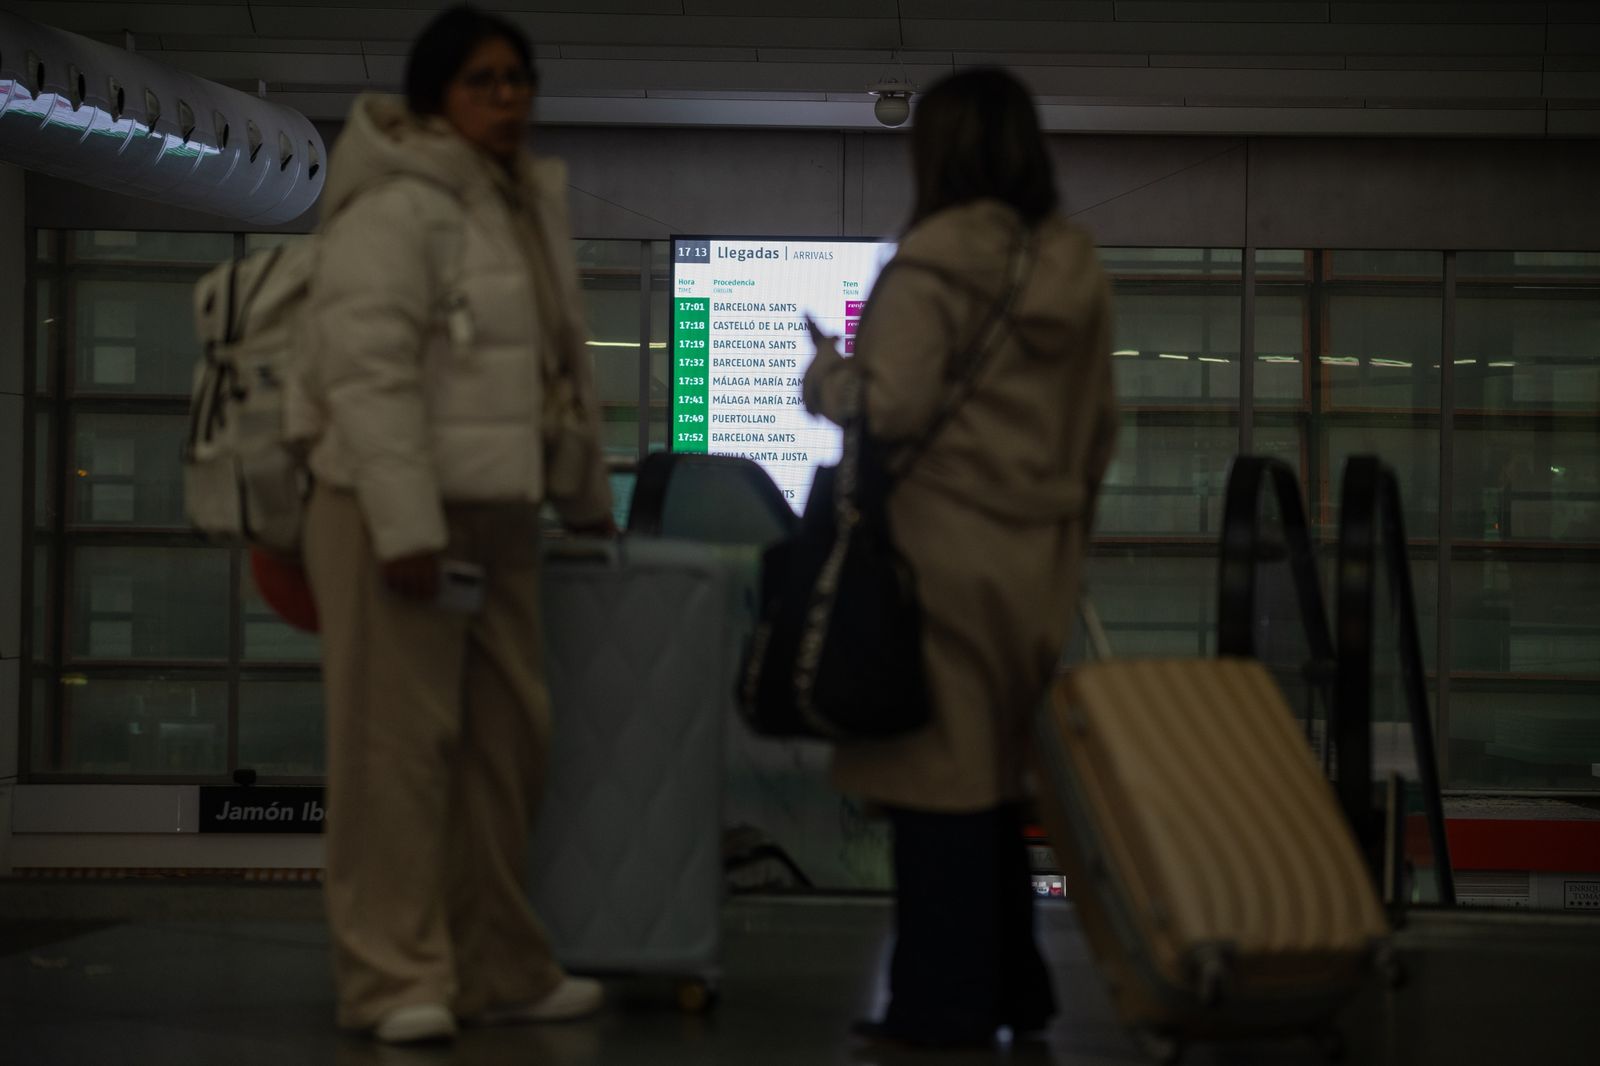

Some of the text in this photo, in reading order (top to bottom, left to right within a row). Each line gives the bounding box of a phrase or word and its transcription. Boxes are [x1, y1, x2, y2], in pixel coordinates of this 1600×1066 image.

[717, 246, 779, 262] Llegadas
[793, 251, 834, 260] ARRIVALS
[713, 279, 755, 287] Procedencia
[843, 280, 859, 288] Tren
[679, 302, 705, 311] 17:01
[713, 303, 797, 312] BARCELONA SANTS
[679, 321, 705, 330] 17:18
[713, 319, 811, 331] CASTELLÓ DE LA PLAN
[679, 340, 705, 348] 17:19
[713, 340, 797, 350] BARCELONA SANTS
[679, 358, 704, 367] 17:32
[713, 358, 796, 368] BARCELONA SANTS
[678, 377, 704, 386] 17:33
[712, 375, 804, 387] MÁLAGA MARÍA ZAM
[678, 396, 704, 404] 17:41
[712, 393, 805, 405] MÁLAGA MARÍA ZAM
[678, 414, 704, 423] 17:49
[712, 414, 776, 424] PUERTOLLANO
[678, 433, 703, 442] 17:52
[712, 433, 796, 442] BARCELONA SANTS
[749, 452, 778, 461] SANTA
[781, 452, 808, 461] JUSTA
[215, 800, 327, 821] Jamón Ib
[1568, 884, 1600, 893] ENRIQU
